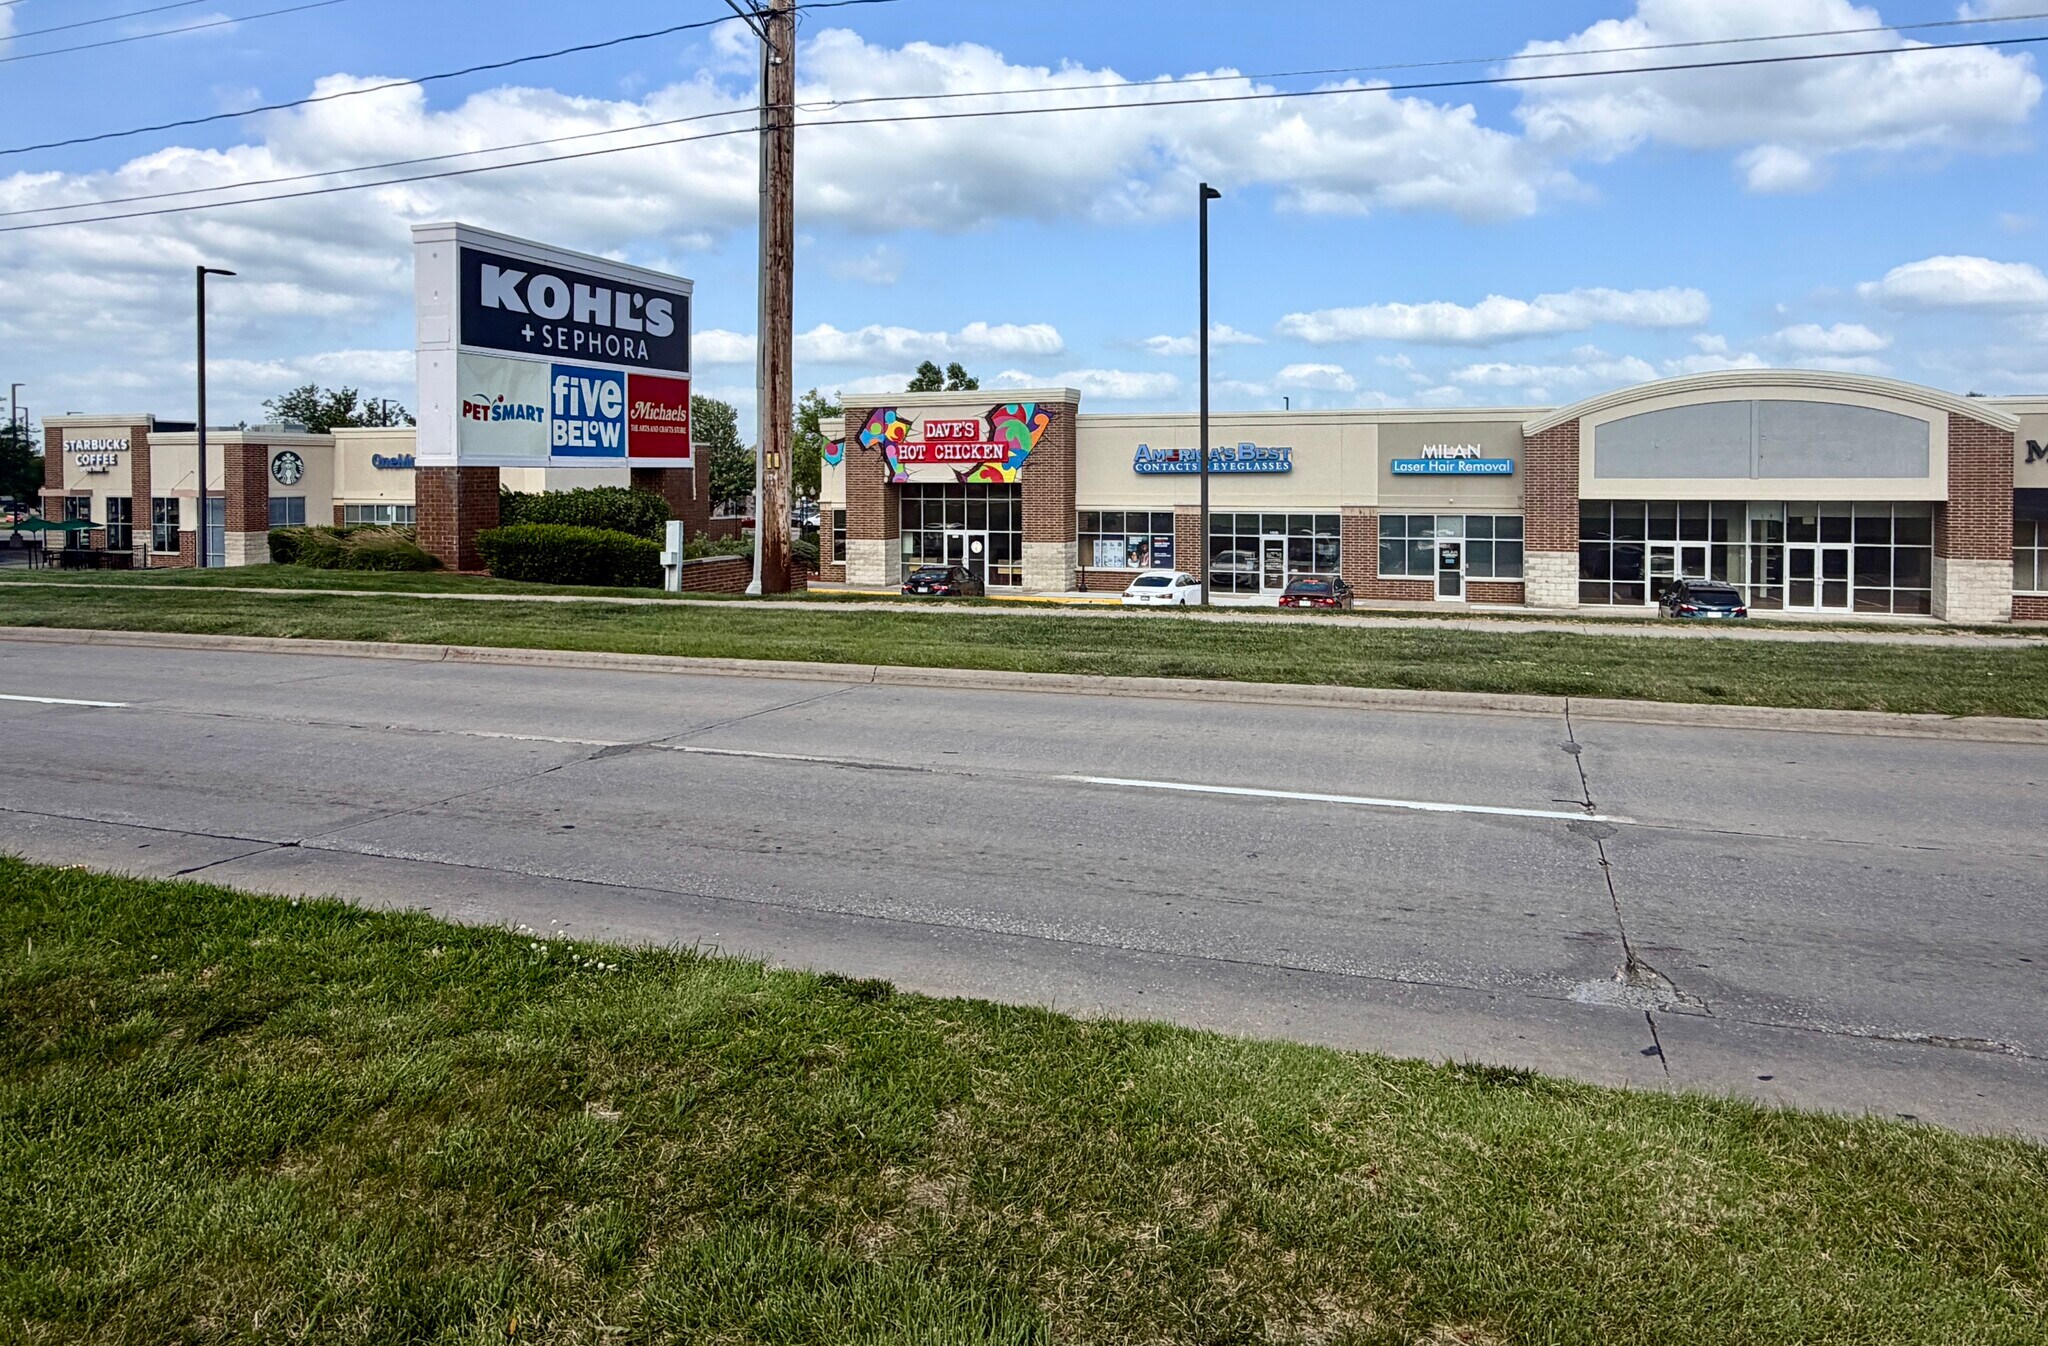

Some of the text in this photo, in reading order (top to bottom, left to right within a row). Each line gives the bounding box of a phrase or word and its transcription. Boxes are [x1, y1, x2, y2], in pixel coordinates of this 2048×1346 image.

[481, 263, 675, 338] KOHL'S
[552, 375, 623, 418] five
[630, 401, 687, 422] Michaels
[552, 420, 621, 448] BELOW
[659, 425, 674, 434] CRAFTS
[926, 422, 975, 438] DAVE'S
[64, 439, 129, 452] STARBUCKS
[898, 443, 1004, 460] HOT CHICKEN
[1134, 444, 1236, 463] AMERIA'S
[1421, 443, 1481, 459] MILAN
[75, 453, 117, 466] COFFEE
[1135, 461, 1289, 472] CONTACTS EYEGLASSES
[1394, 460, 1510, 472] Laser Hair Removal
